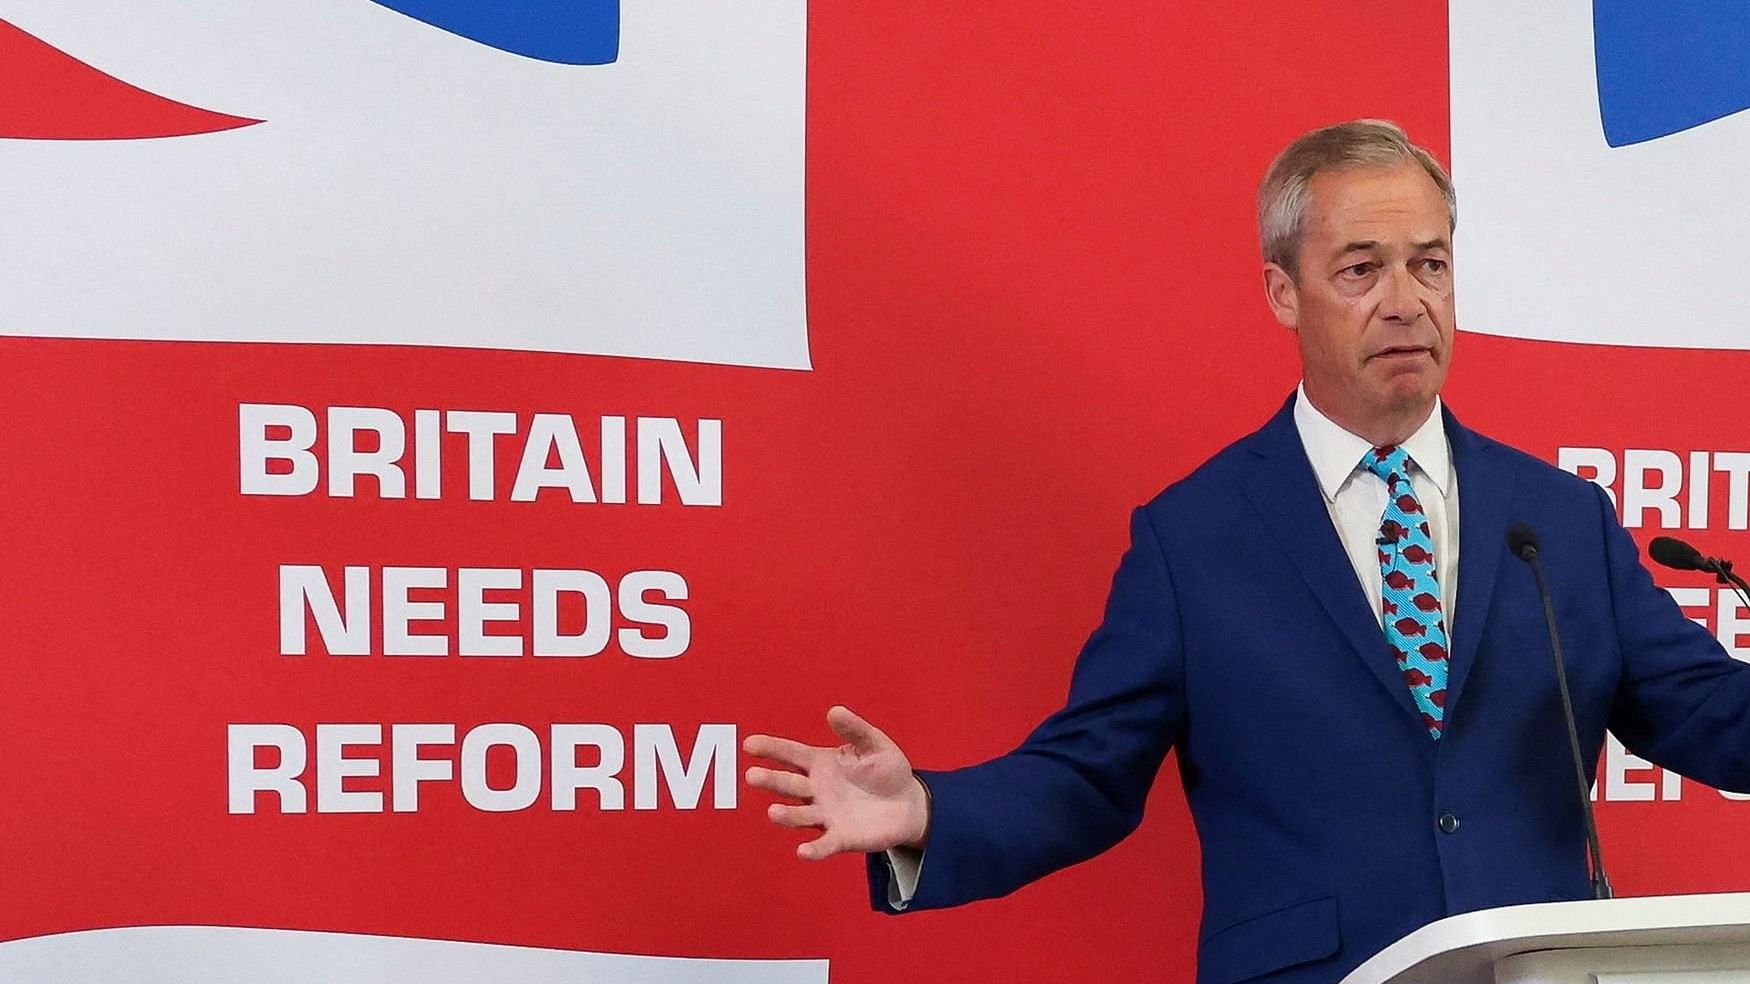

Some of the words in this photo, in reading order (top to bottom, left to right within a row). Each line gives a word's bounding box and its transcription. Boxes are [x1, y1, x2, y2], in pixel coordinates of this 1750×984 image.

[239, 403, 722, 506] BRITAIN
[279, 564, 690, 658] NEEDS
[227, 723, 737, 814] REFORM
